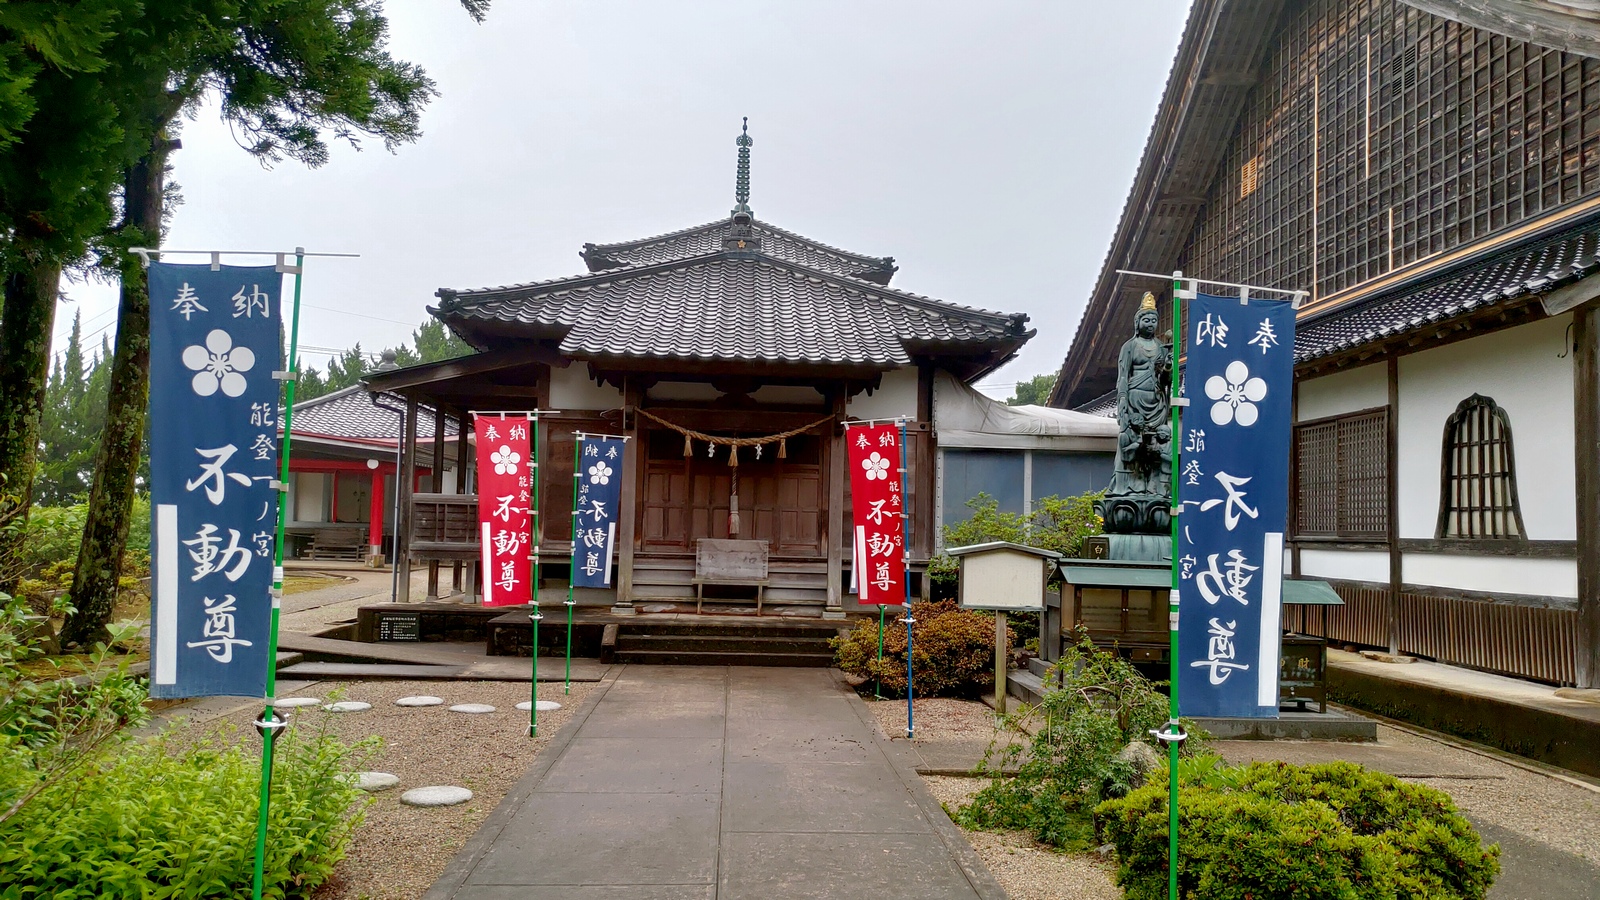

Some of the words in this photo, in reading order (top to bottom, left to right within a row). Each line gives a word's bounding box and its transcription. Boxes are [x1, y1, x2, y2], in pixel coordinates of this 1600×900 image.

[170, 282, 270, 321] 奉納
[484, 424, 526, 442] 奉納
[855, 432, 895, 450] 奉納
[182, 443, 252, 663] 不動尊
[492, 495, 520, 592] 不動尊
[866, 499, 896, 591] 不動尊
